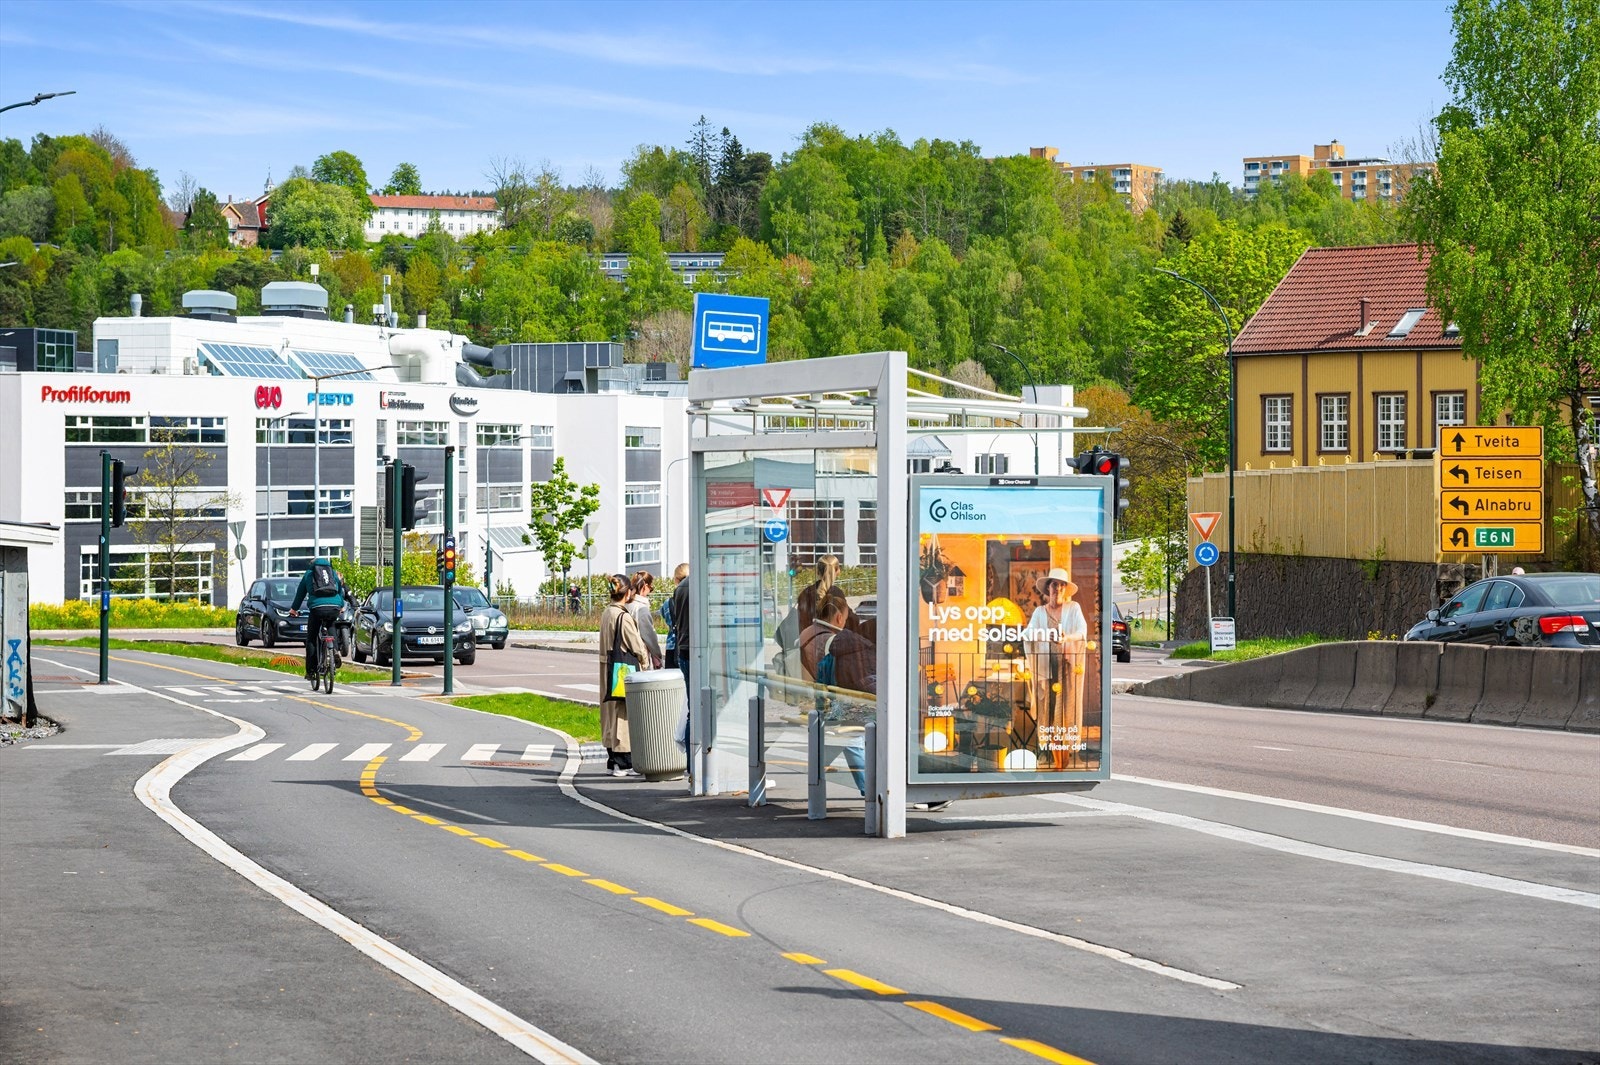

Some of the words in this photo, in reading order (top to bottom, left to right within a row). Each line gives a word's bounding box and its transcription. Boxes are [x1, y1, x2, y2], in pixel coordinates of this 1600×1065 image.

[41, 385, 131, 403] Profilforum
[307, 392, 354, 406] FESTO
[1475, 435, 1520, 448] Tveita
[1475, 467, 1522, 479] Teisen
[950, 501, 974, 511] Clas
[1475, 498, 1531, 511] Alnabru
[950, 511, 986, 521] Ohlson
[928, 601, 961, 622] Lys
[965, 605, 1005, 623] opp
[928, 623, 973, 642] med
[978, 623, 1063, 642] solskinn!
[1039, 725, 1055, 733] Sett
[1056, 725, 1067, 734] lys
[1068, 725, 1078, 734] på
[1039, 743, 1047, 751] Vi
[1048, 743, 1069, 751] fikser
[1071, 743, 1087, 751] det!
